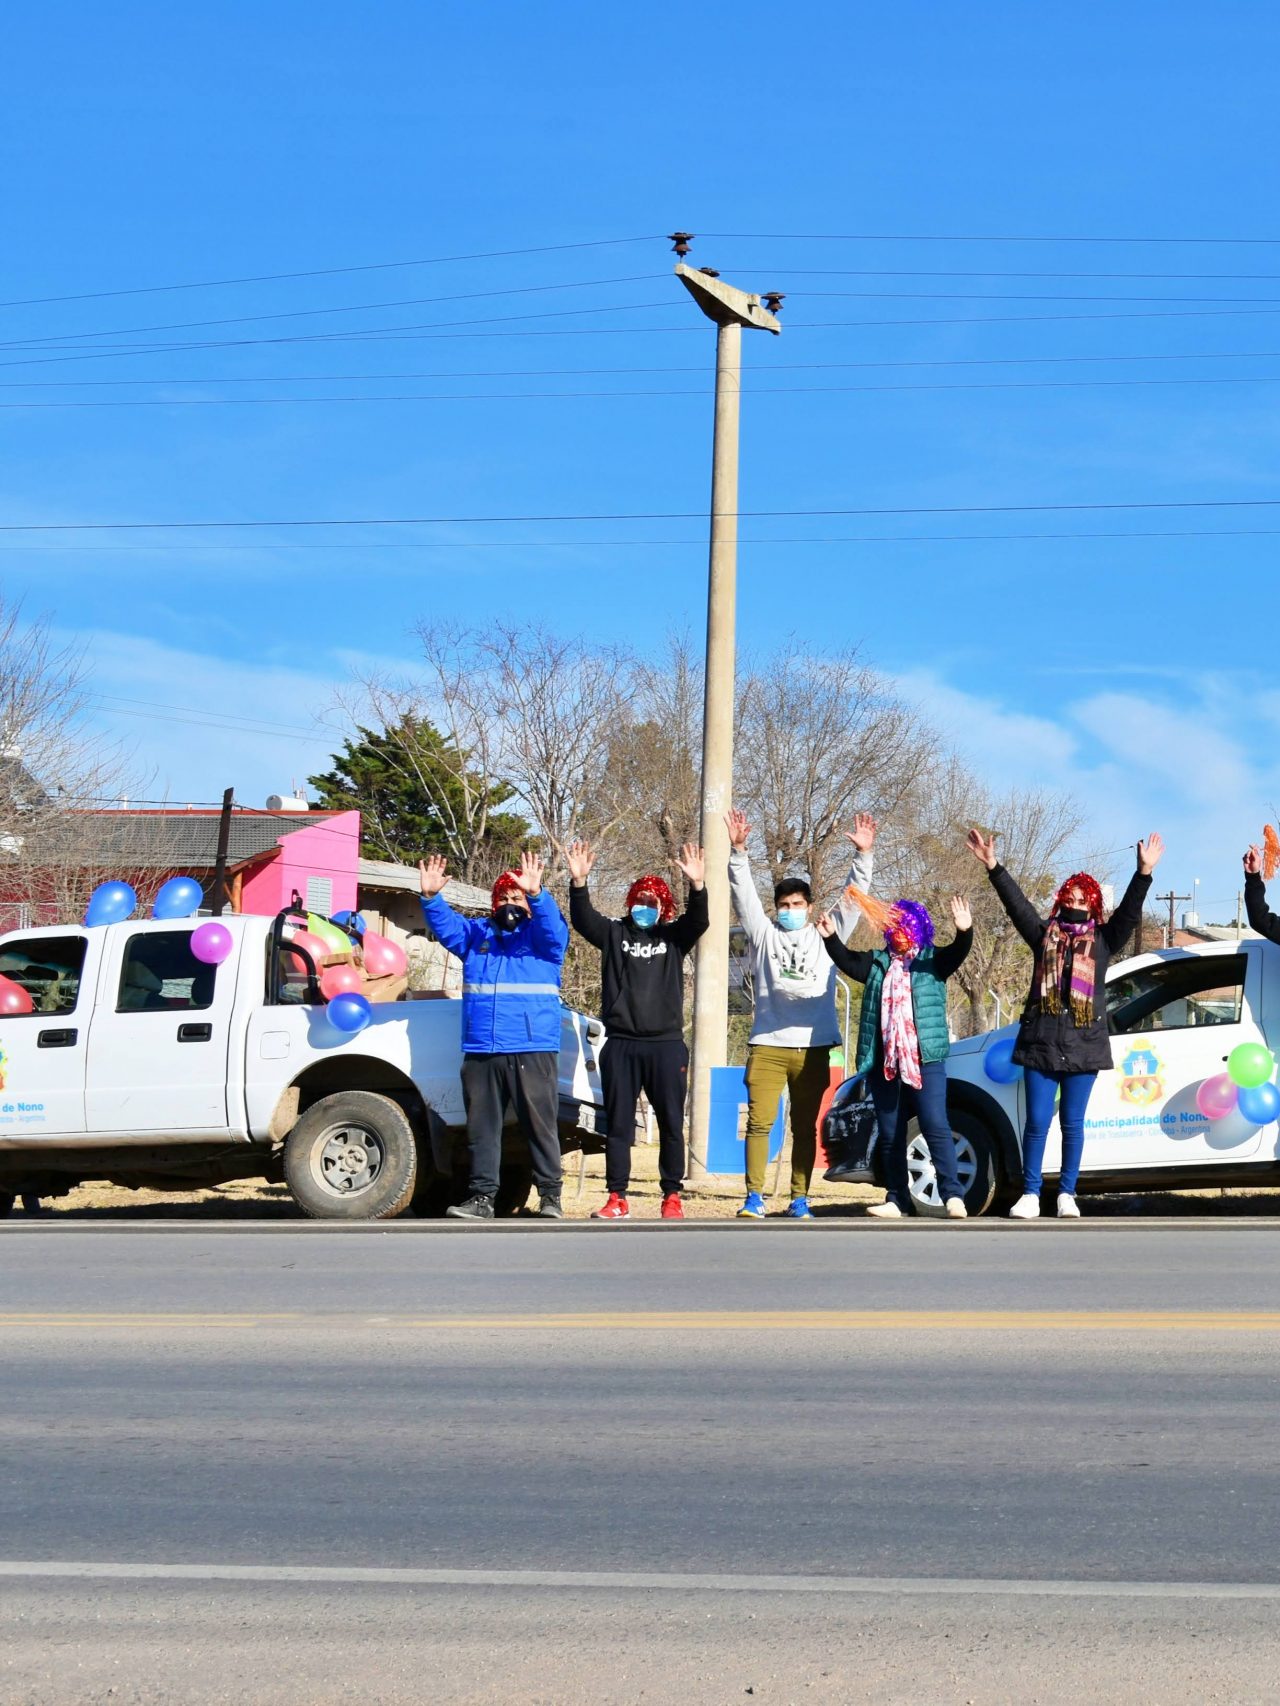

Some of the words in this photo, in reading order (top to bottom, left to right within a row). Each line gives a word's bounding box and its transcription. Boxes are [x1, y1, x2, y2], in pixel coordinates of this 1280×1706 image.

[621, 940, 667, 958] adidas
[2, 1102, 15, 1113] de
[17, 1101, 45, 1112] Nono
[1084, 1113, 1160, 1129] Municipalidad
[1162, 1112, 1177, 1124] de
